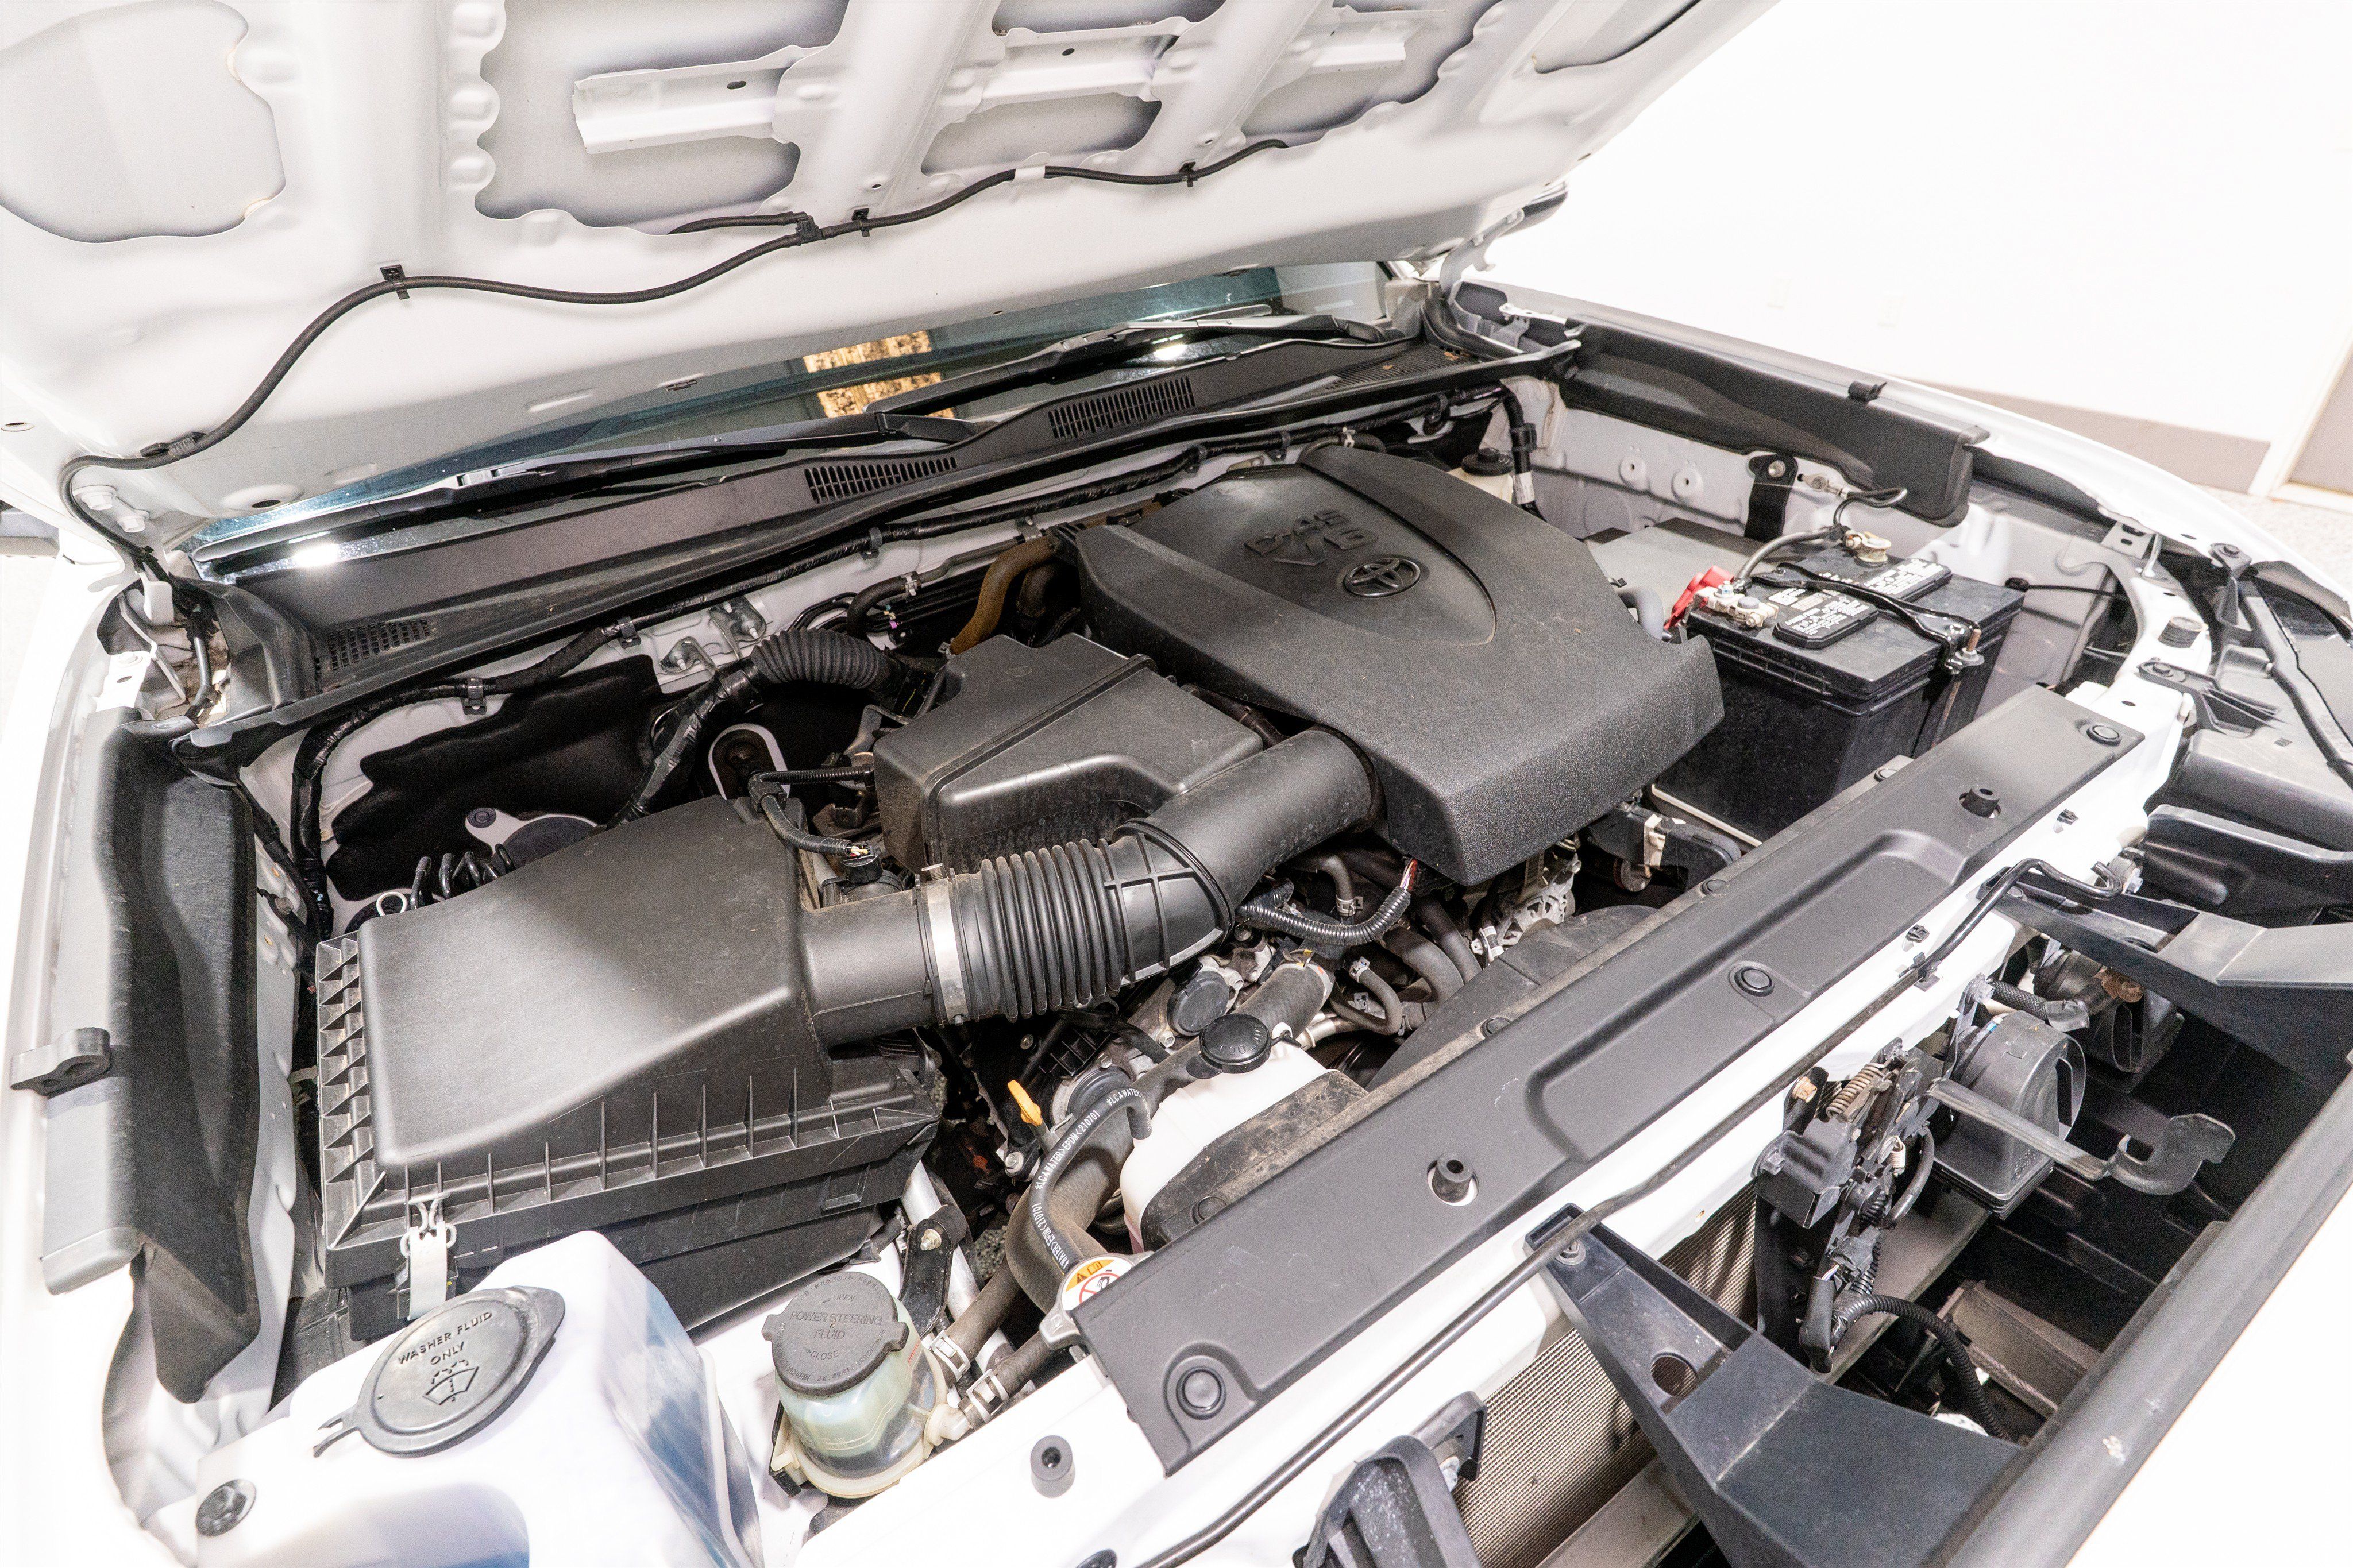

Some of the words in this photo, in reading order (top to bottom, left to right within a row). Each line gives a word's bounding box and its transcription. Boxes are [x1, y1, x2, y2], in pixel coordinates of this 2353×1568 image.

[833, 1293, 856, 1302] OPEN
[789, 1311, 828, 1322] POWER
[830, 1313, 883, 1326] STEERING
[398, 1333, 451, 1364] WASHER
[457, 1312, 492, 1335] FLUID
[813, 1328, 845, 1340] FLUID
[431, 1341, 464, 1365] ONLY
[811, 1350, 839, 1361] CLOSE
